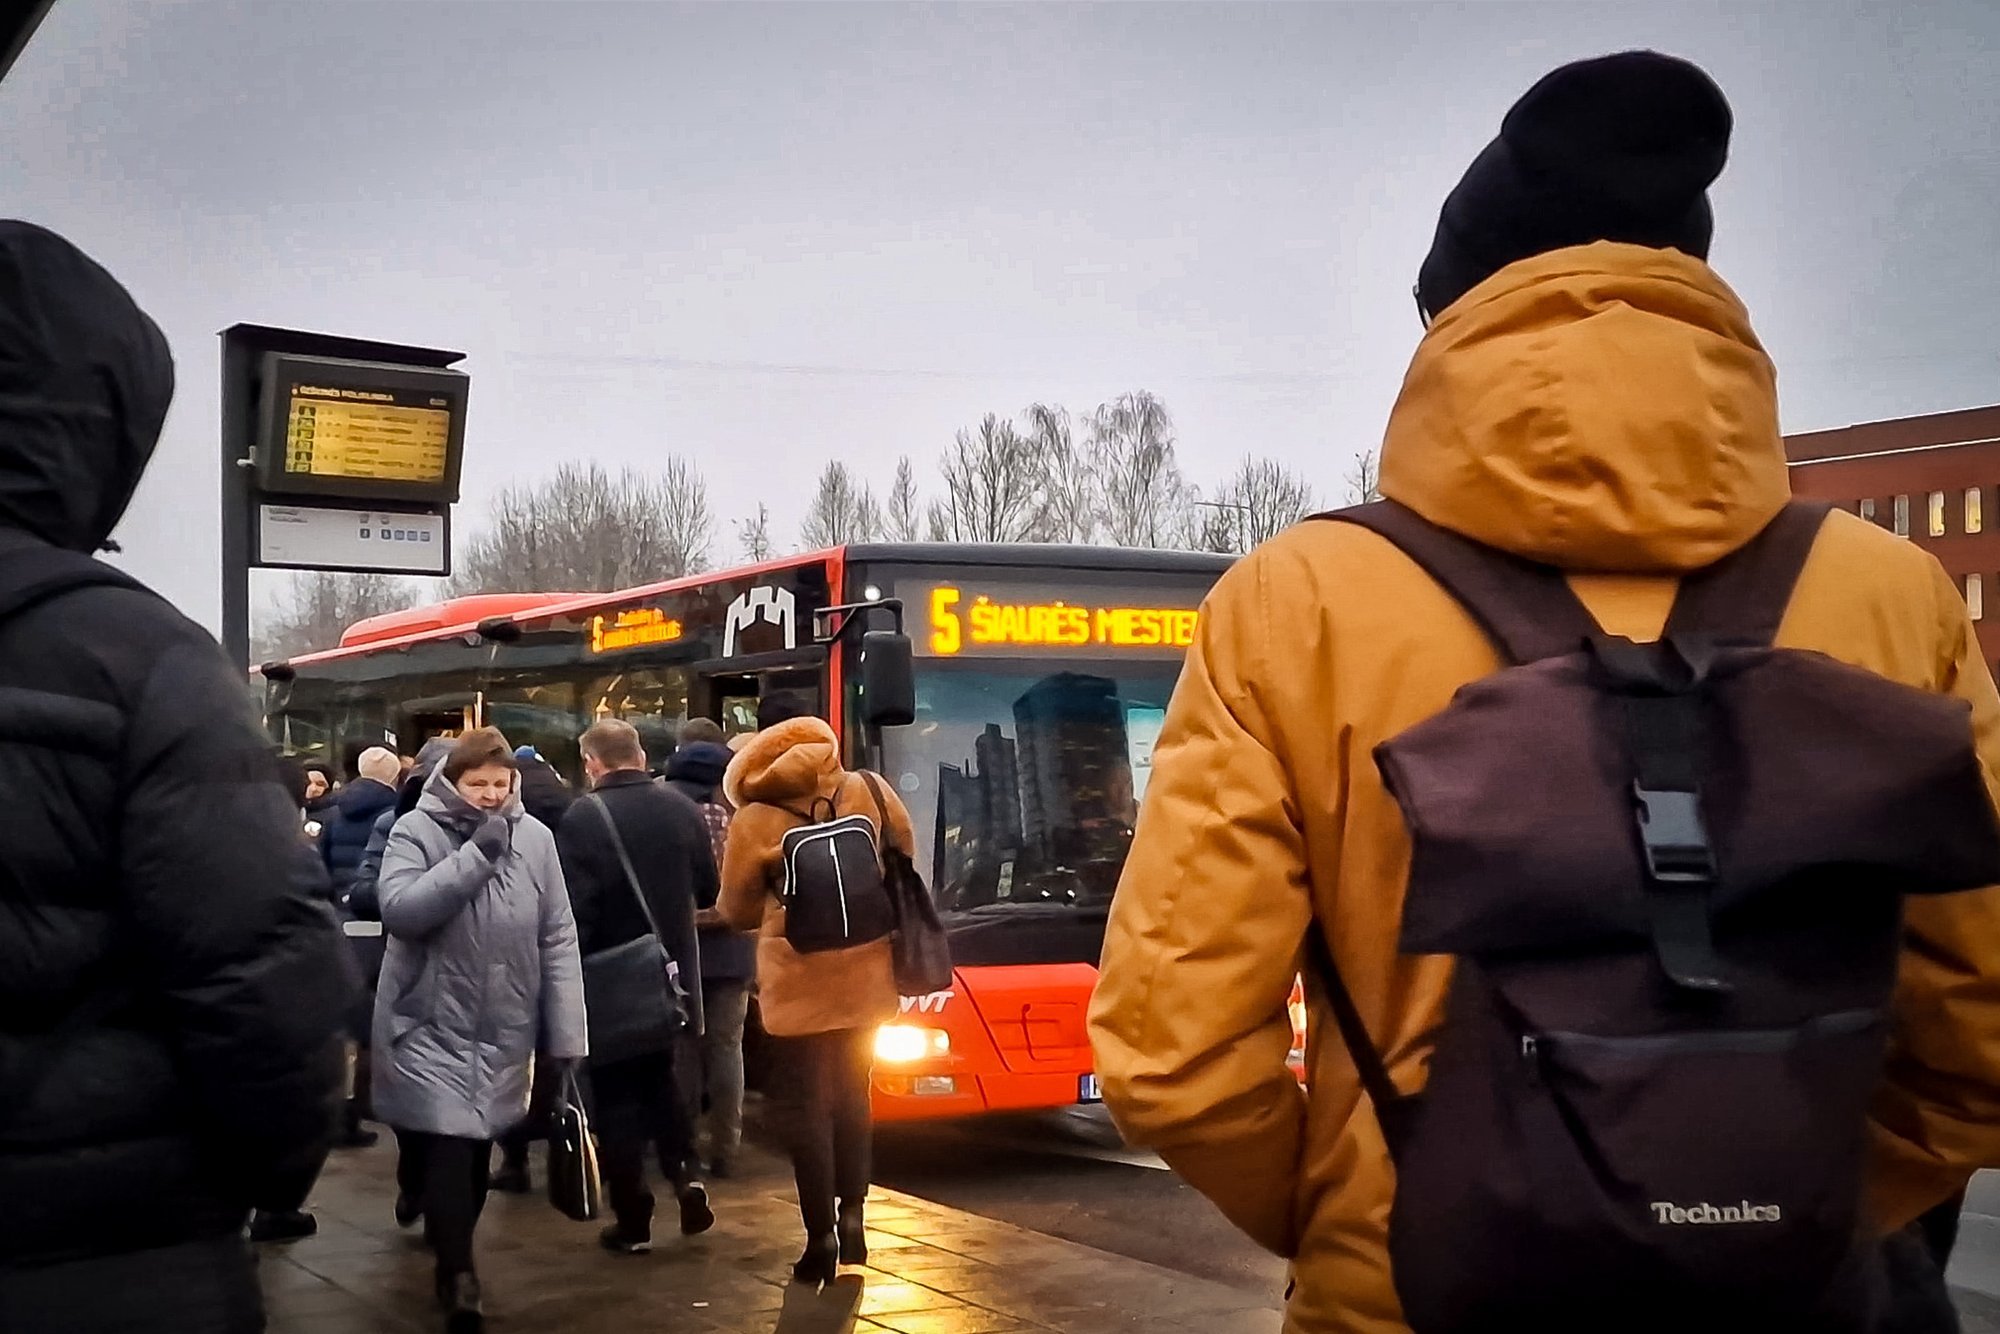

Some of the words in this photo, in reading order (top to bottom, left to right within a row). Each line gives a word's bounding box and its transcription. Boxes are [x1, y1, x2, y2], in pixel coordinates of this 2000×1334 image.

[932, 587, 961, 654] 5
[970, 595, 1090, 645] ŠIAURĖS
[1650, 1199, 1781, 1224] Technics
